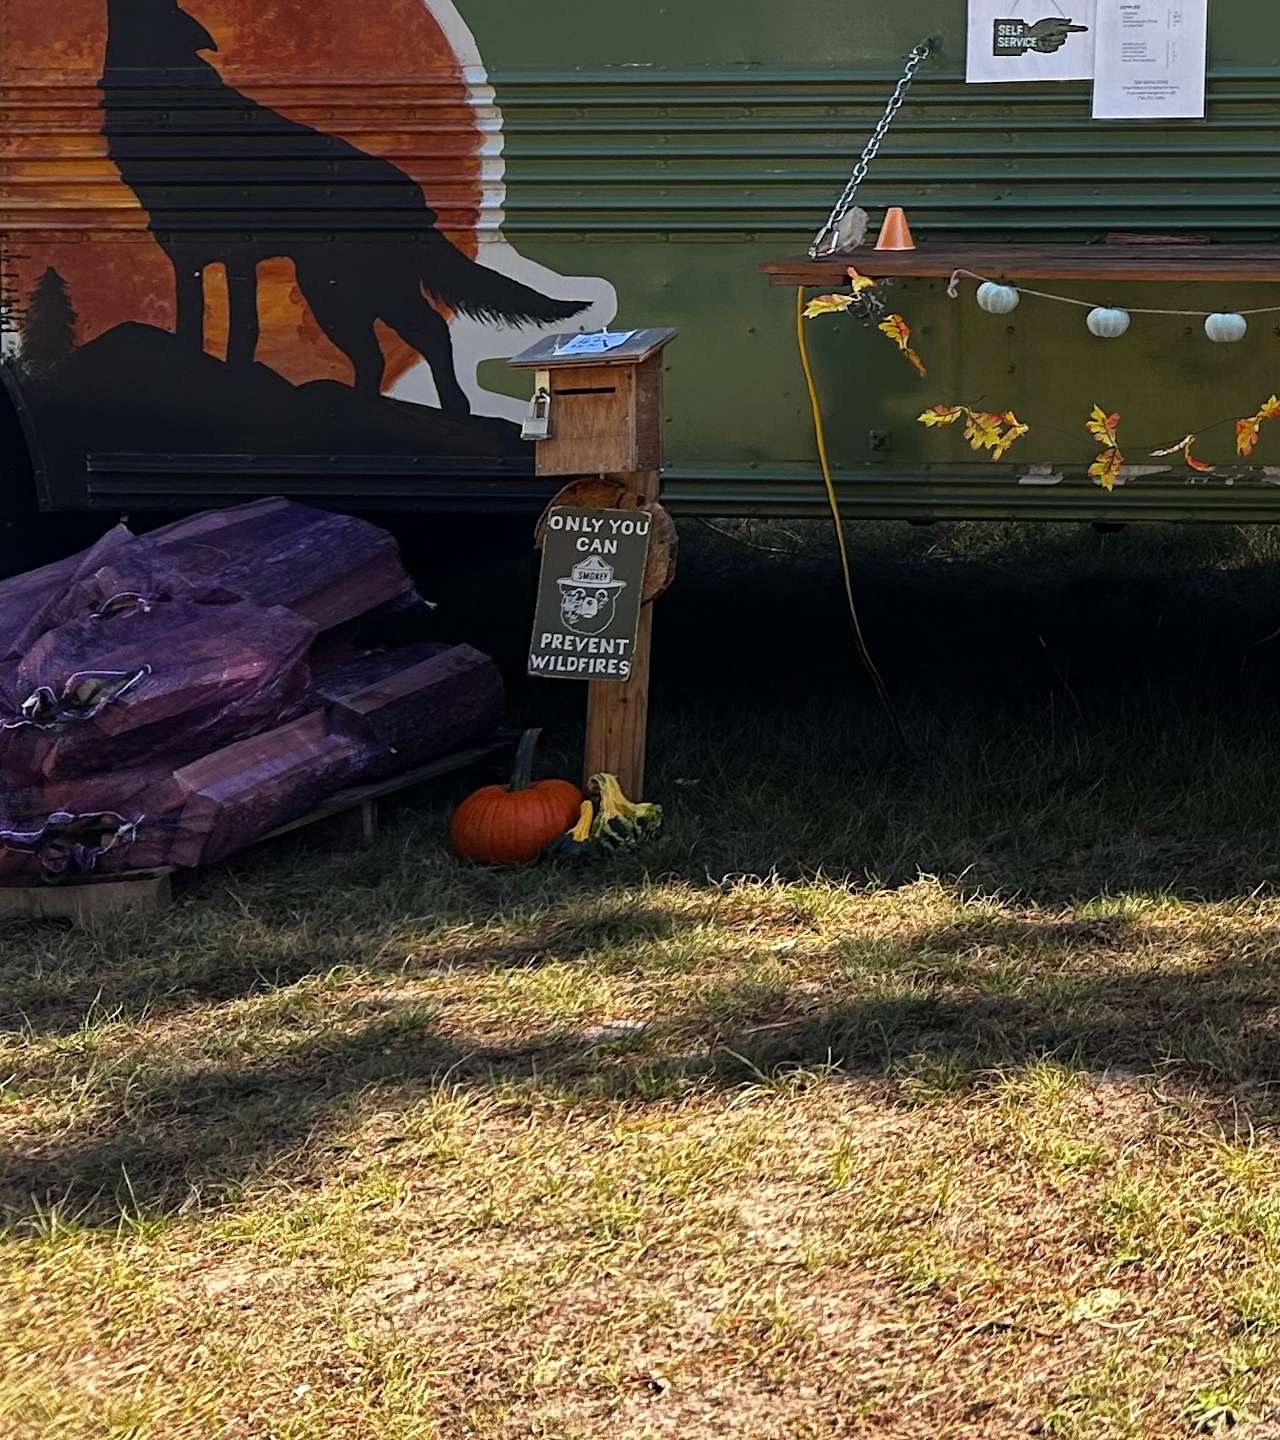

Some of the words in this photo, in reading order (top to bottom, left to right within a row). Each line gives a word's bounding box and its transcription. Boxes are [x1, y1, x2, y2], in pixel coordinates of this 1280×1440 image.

[998, 24, 1024, 36] SELF
[997, 36, 1038, 48] SERVICE
[550, 515, 604, 534] ONLY
[609, 519, 649, 536] YOU
[576, 537, 618, 554] CAN
[578, 571, 609, 581] SMOKEY
[540, 632, 630, 656] PREVENT
[530, 653, 630, 676] WILDFIRES
